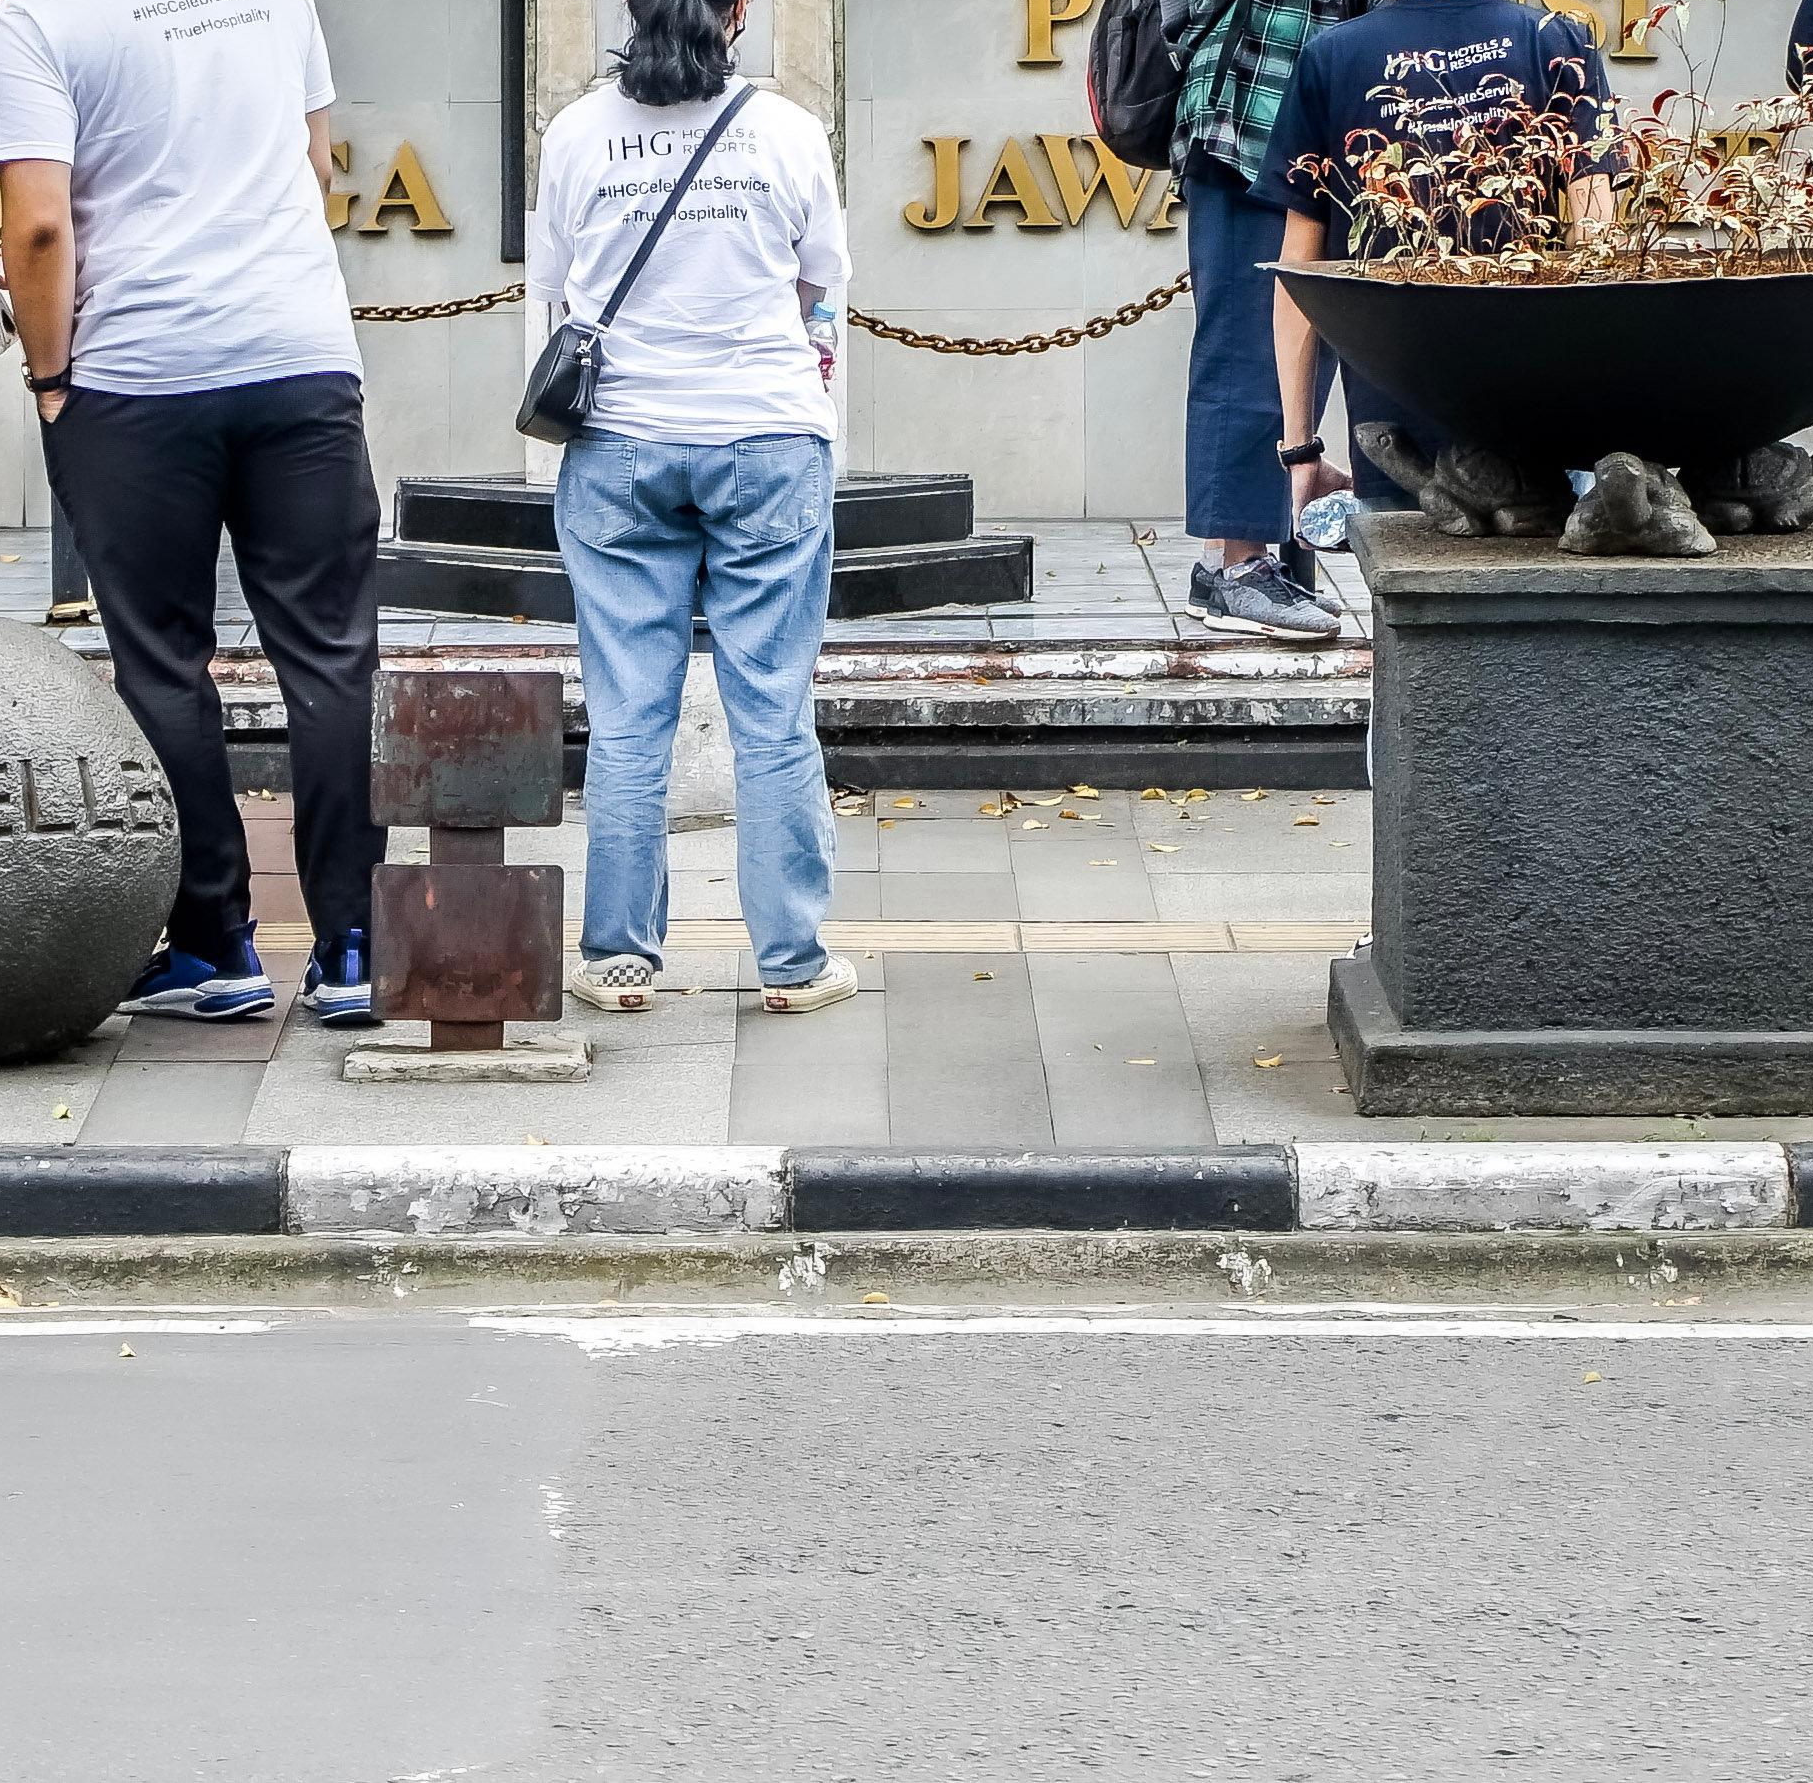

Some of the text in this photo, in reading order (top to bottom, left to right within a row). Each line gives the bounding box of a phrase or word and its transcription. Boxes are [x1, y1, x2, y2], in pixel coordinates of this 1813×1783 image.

[164, 8, 271, 43] #TrueHospitality
[1447, 38, 1499, 61] HOTELS
[1500, 36, 1513, 48] &
[1449, 47, 1509, 72] RESORTS
[608, 130, 673, 162] IHG
